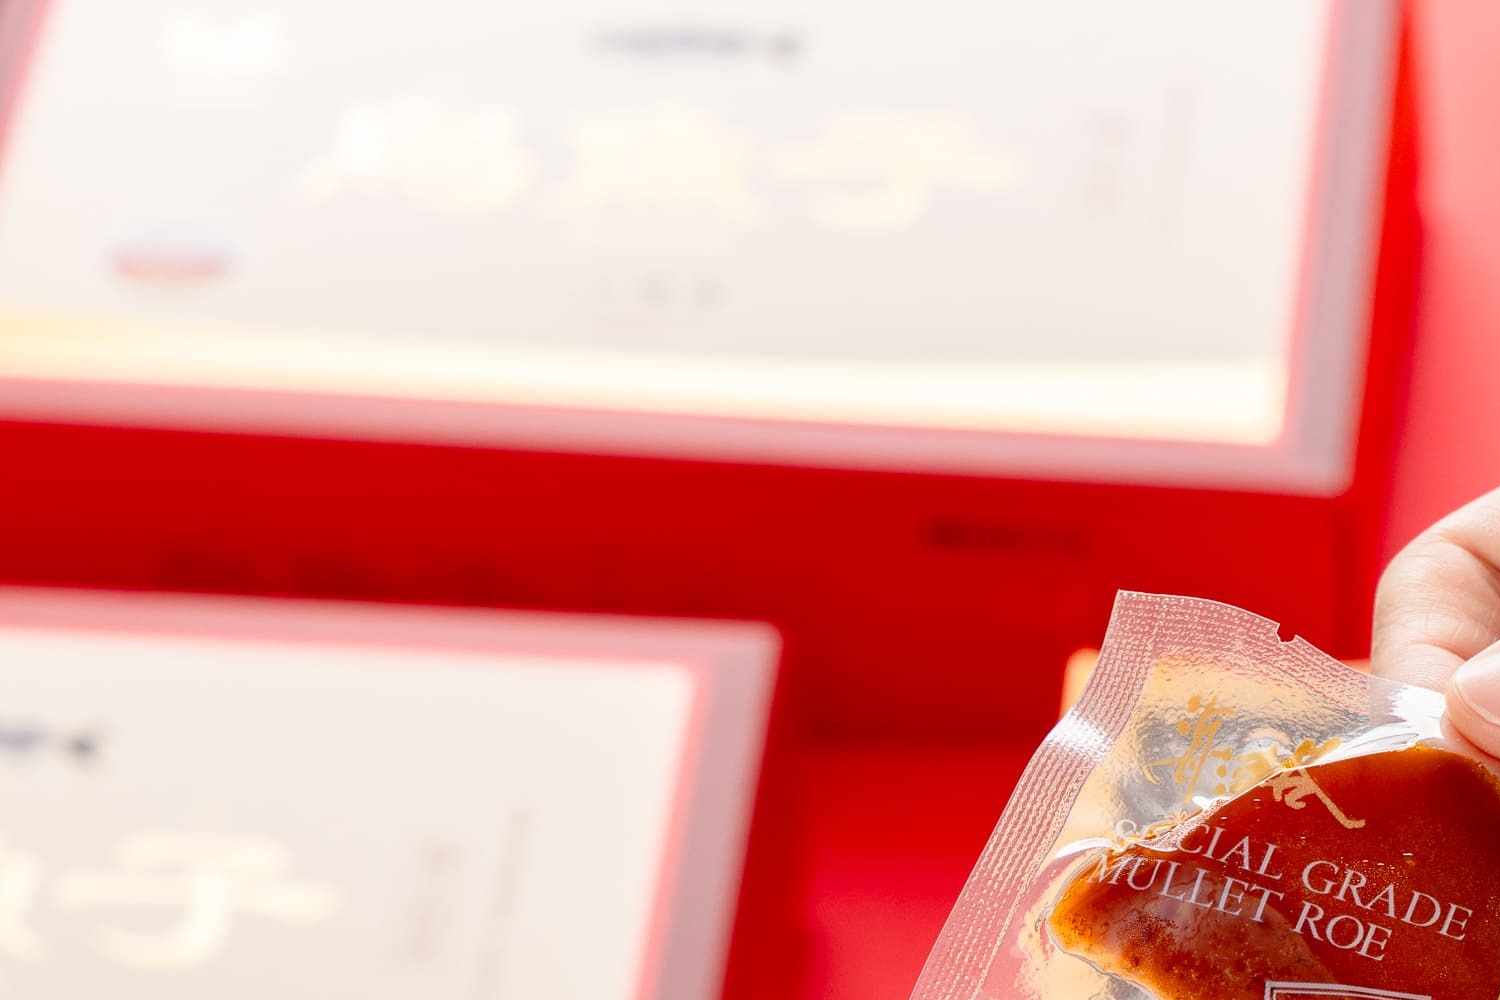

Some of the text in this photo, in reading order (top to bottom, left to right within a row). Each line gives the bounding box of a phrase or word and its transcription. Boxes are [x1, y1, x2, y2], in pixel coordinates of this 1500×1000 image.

[1086, 854, 1393, 961] MULLET ROE
[1112, 818, 1474, 942] SCIAL GRADE
